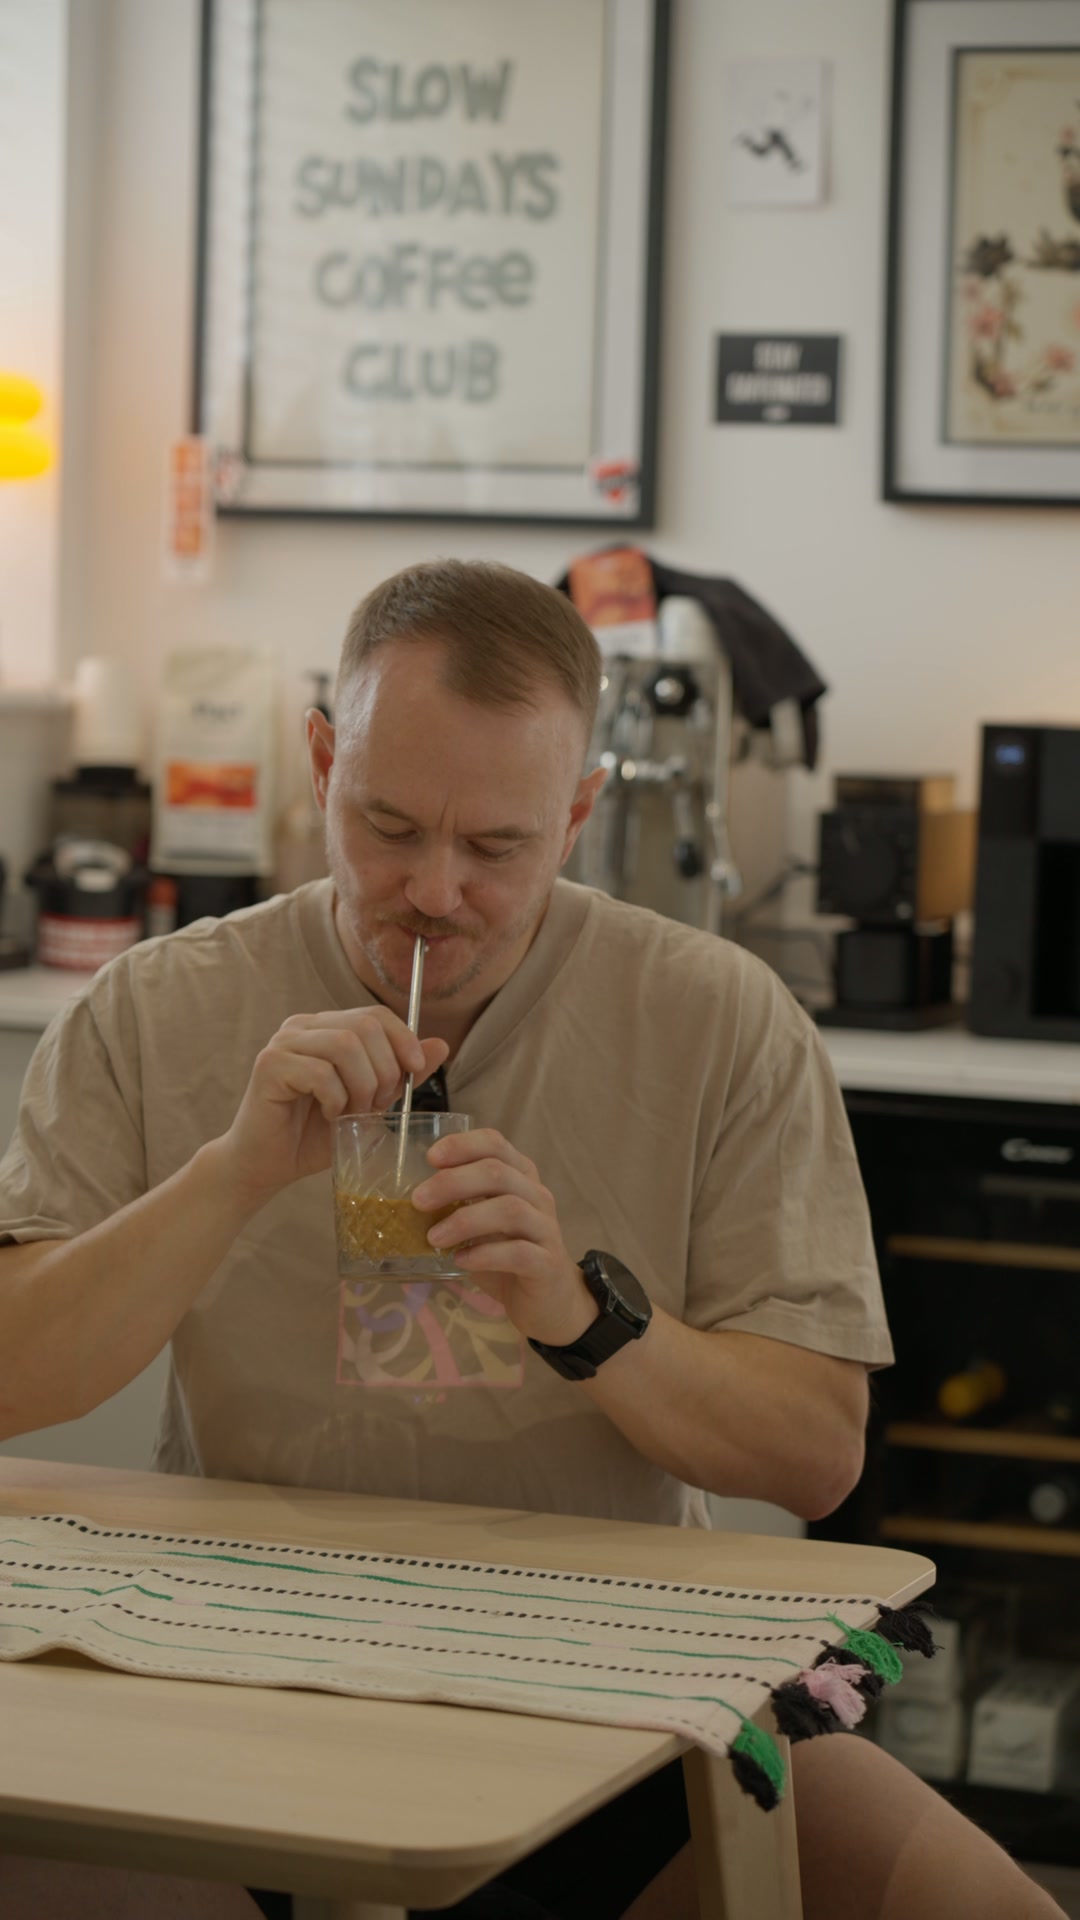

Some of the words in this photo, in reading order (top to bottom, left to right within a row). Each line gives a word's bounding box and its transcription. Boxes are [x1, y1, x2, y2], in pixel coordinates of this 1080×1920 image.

[346, 55, 514, 124] SLOW
[296, 151, 561, 219] SUNDAYS
[343, 341, 502, 404] CLUB
